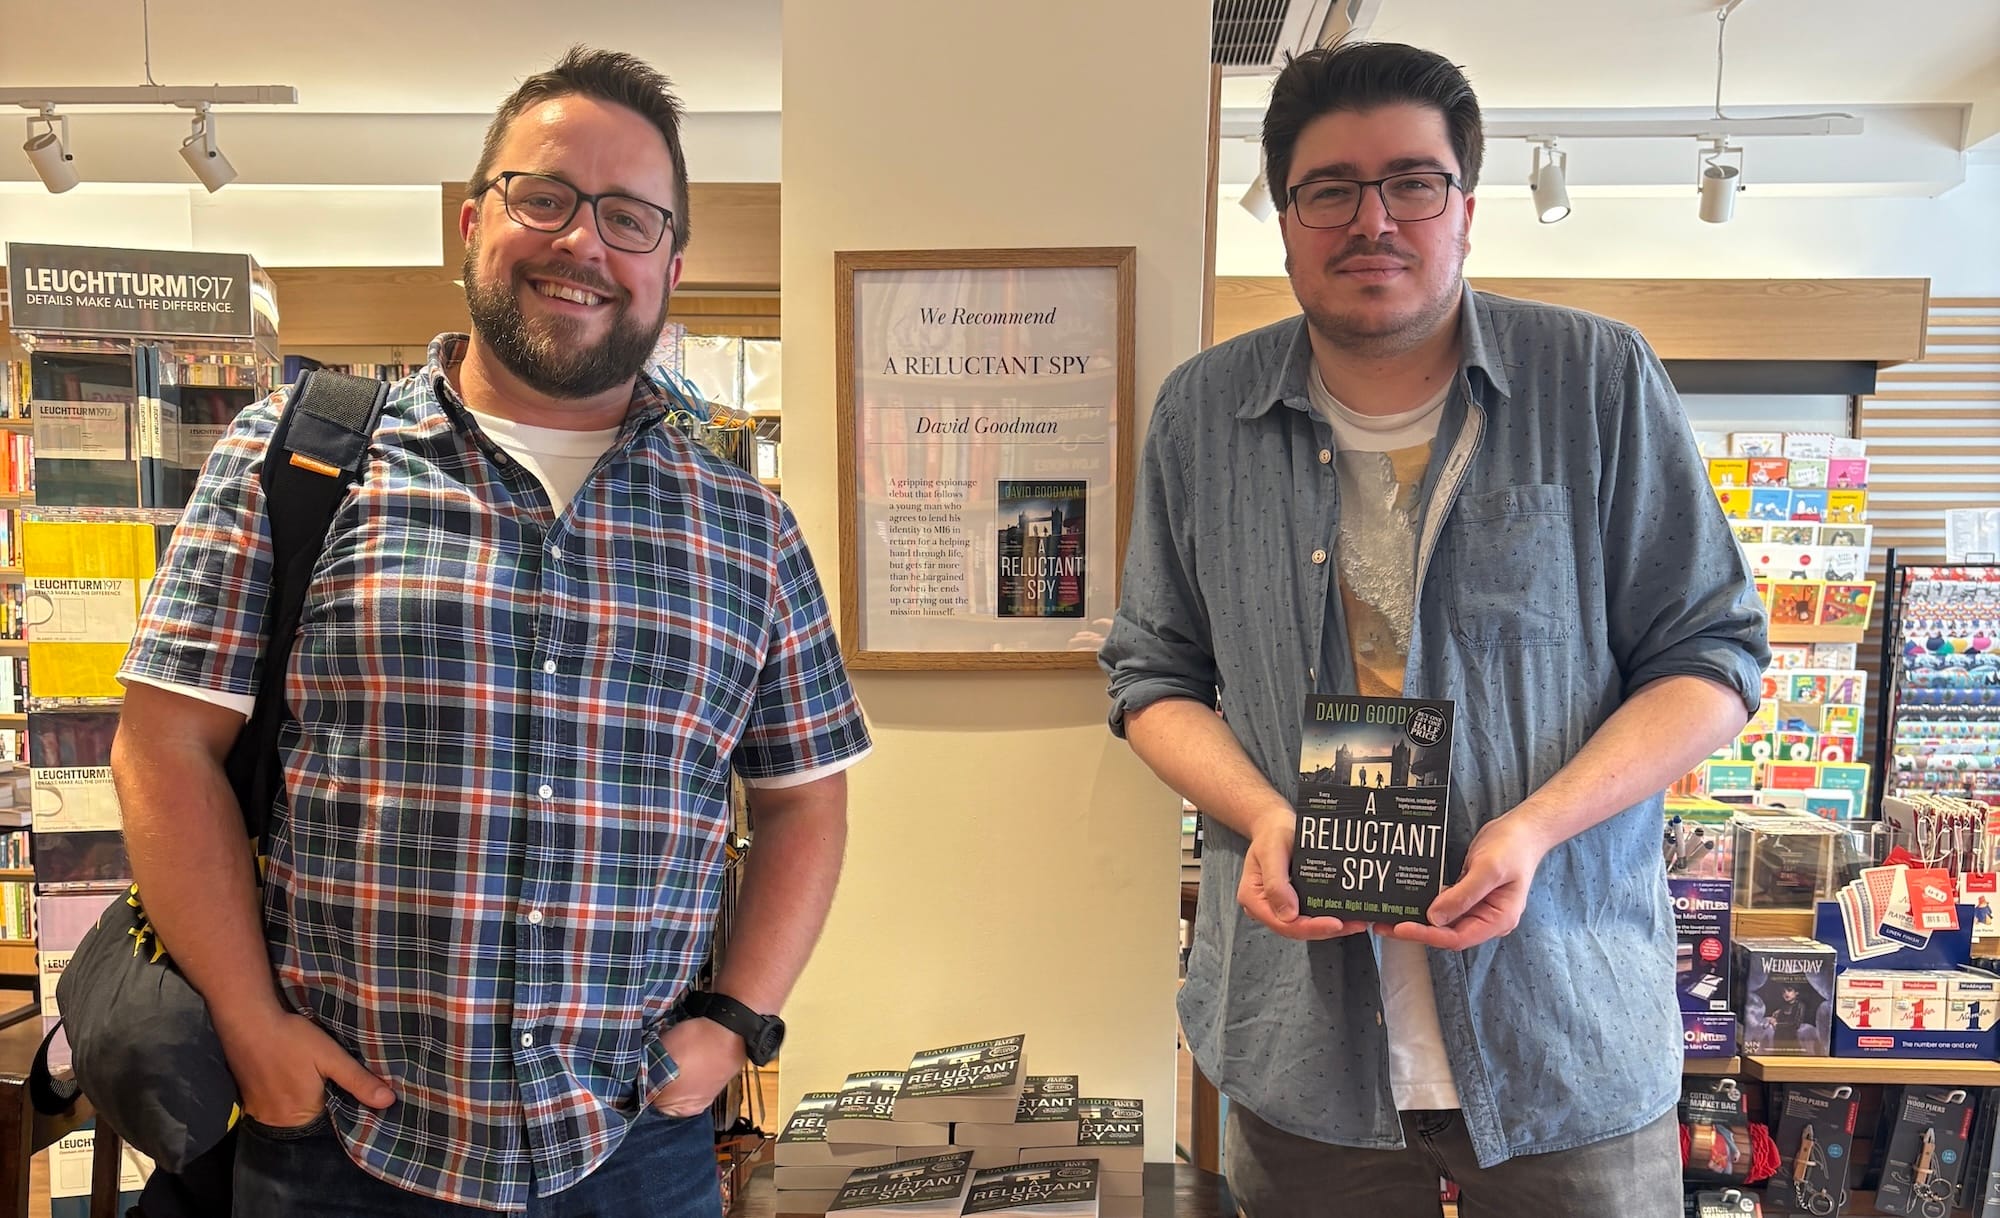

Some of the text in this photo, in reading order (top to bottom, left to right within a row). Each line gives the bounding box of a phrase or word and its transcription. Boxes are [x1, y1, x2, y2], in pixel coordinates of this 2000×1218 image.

[25, 268, 234, 300] LEUCHTTURM1917
[27, 294, 235, 314] DETAILS MAKE ALL THE DIFFERENCE.
[920, 307, 1057, 325] We Recommend
[883, 356, 1091, 375] A RELUCTANT SPY
[40, 405, 112, 417] LEUCHTTURM1917
[916, 416, 1058, 434] David Goodman
[897, 478, 933, 488] gripping
[935, 478, 978, 488] espionage
[889, 490, 963, 498] debut that follows
[1005, 485, 1080, 498] DAVID GOODMAN
[896, 503, 922, 512] young
[944, 502, 962, 510] who
[889, 515, 916, 523] agrees
[928, 514, 947, 522] lend
[949, 514, 961, 522] his
[889, 526, 921, 535] identity
[918, 537, 930, 545] for
[939, 537, 970, 547] helping
[1038, 538, 1045, 553] A
[889, 549, 964, 559] hand through life,
[889, 561, 904, 569] but
[905, 562, 922, 570] gets
[924, 561, 935, 569] far
[1001, 556, 1083, 577] RELUCTANT
[923, 573, 964, 582] bargained
[34, 579, 122, 590] LEUCHTTURM1917
[889, 584, 901, 592] for
[903, 584, 926, 592] when
[928, 584, 939, 592] he
[1027, 579, 1056, 600] SPY
[890, 597, 901, 606] up
[902, 597, 937, 606] carrying
[923, 608, 956, 616] himself.
[1316, 702, 1413, 725] DAVID GOOD
[1413, 720, 1439, 734] HALF
[1410, 728, 1437, 742] PRICE
[38, 769, 112, 779] LEUCHTTURM1
[1364, 791, 1377, 815] A
[1300, 816, 1442, 858] RELUCTANT
[1341, 857, 1391, 892] SPY
[1307, 896, 1323, 907] Right
[1345, 899, 1362, 911] Right
[1382, 902, 1403, 915] Wrong
[1683, 912, 1697, 920] Mini
[1697, 912, 1717, 920] Game
[1761, 957, 1823, 974] WEDNESDAY
[1856, 997, 1872, 1028] 1
[1910, 999, 1926, 1030] 1
[1966, 1001, 1982, 1030] 1
[1965, 1042, 1978, 1050] only
[908, 1060, 1018, 1085] RELUCTANT
[940, 1075, 980, 1088] SPY
[840, 1096, 895, 1105] RELU
[1018, 1097, 1075, 1108] CTANT
[1690, 1099, 1736, 1111] MARKET BAG
[1907, 1099, 1946, 1113] WOOD PLIERS
[791, 1118, 826, 1128] REL
[1081, 1124, 1142, 1133] CTANT
[844, 1175, 965, 1198] RELUCTANT
[973, 1181, 1094, 1200] RELUCTANT
[878, 1188, 921, 1200] SPY
[1010, 1191, 1053, 1202] SPY
